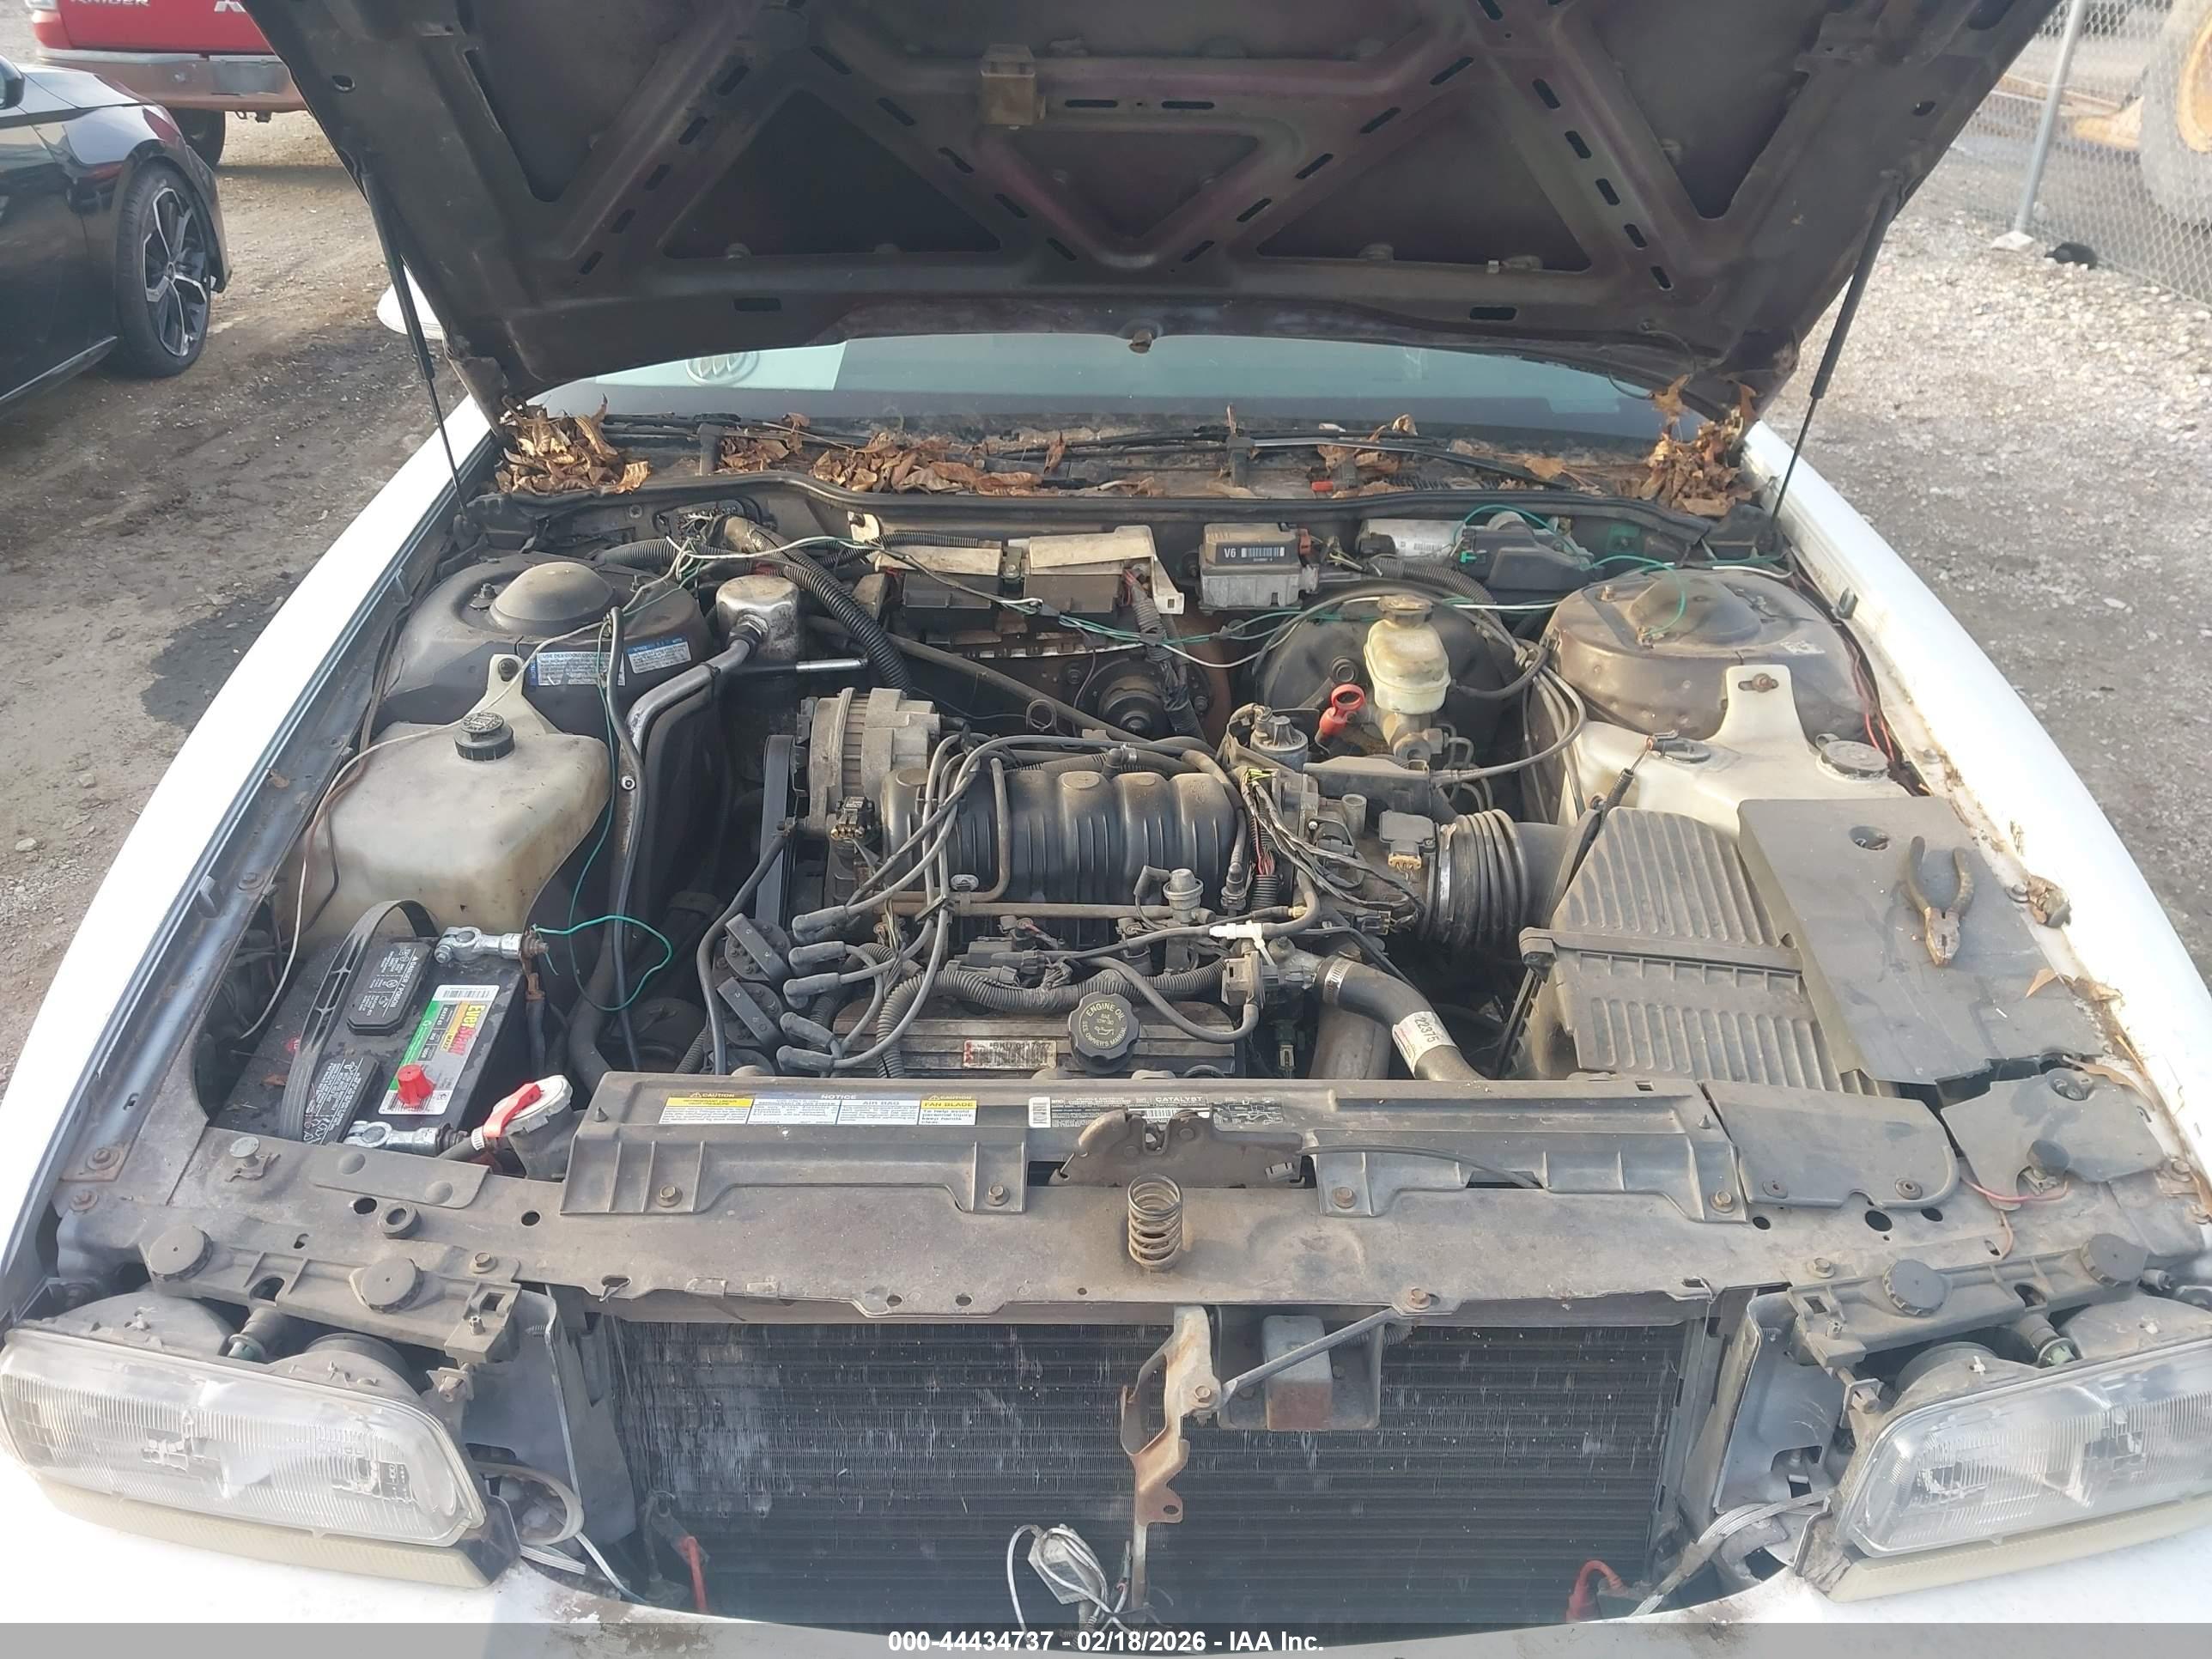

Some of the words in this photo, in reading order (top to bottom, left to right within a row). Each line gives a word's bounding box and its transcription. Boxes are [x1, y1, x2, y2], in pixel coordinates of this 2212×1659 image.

[1224, 548, 1237, 558] V6
[402, 961, 416, 983] DANGER
[390, 987, 404, 1008] POISON
[1085, 1003, 1115, 1017] ENGINE
[1115, 1008, 1125, 1021] OIL
[448, 1005, 486, 1055] EverStart
[1109, 1025, 1127, 1046] MANUAL
[1414, 1017, 1440, 1042] 22375
